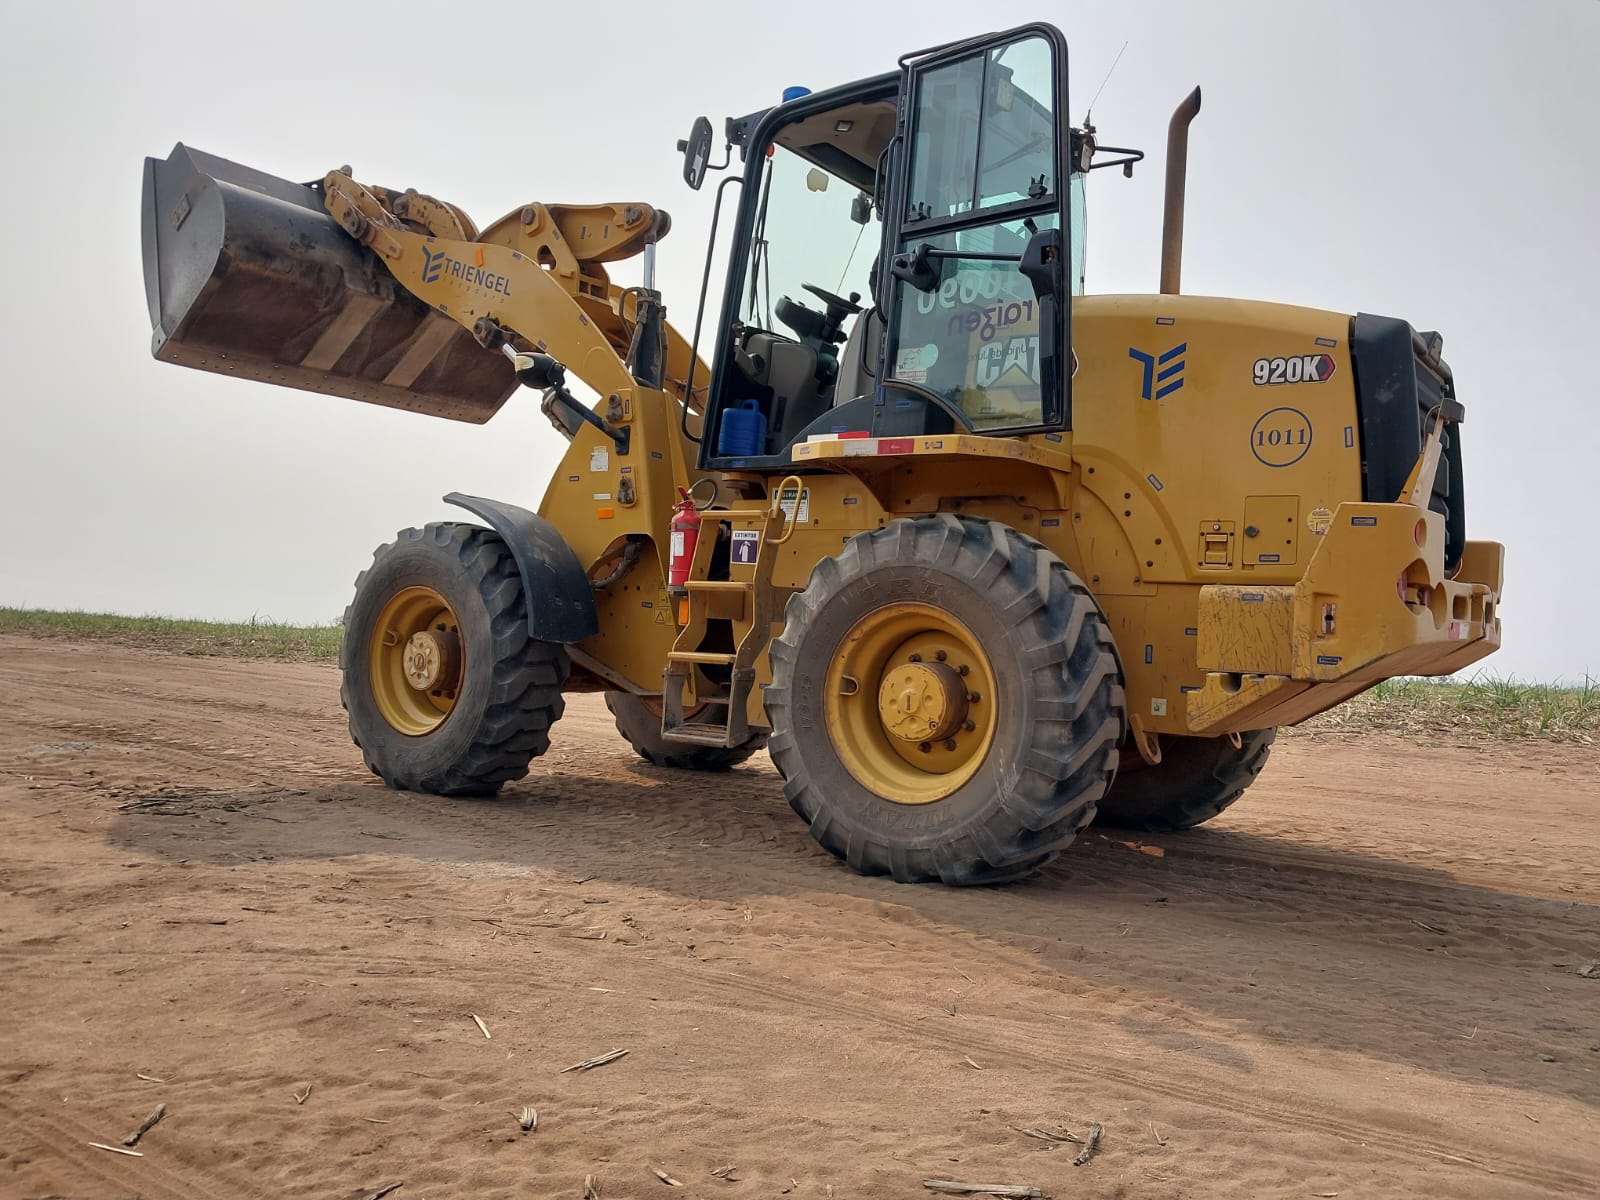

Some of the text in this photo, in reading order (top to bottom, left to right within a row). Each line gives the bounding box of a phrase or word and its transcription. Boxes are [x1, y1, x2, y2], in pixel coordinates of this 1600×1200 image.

[445, 258, 510, 296] TRIENGEL
[1253, 355, 1322, 385] 920K
[1257, 428, 1307, 446] 1011
